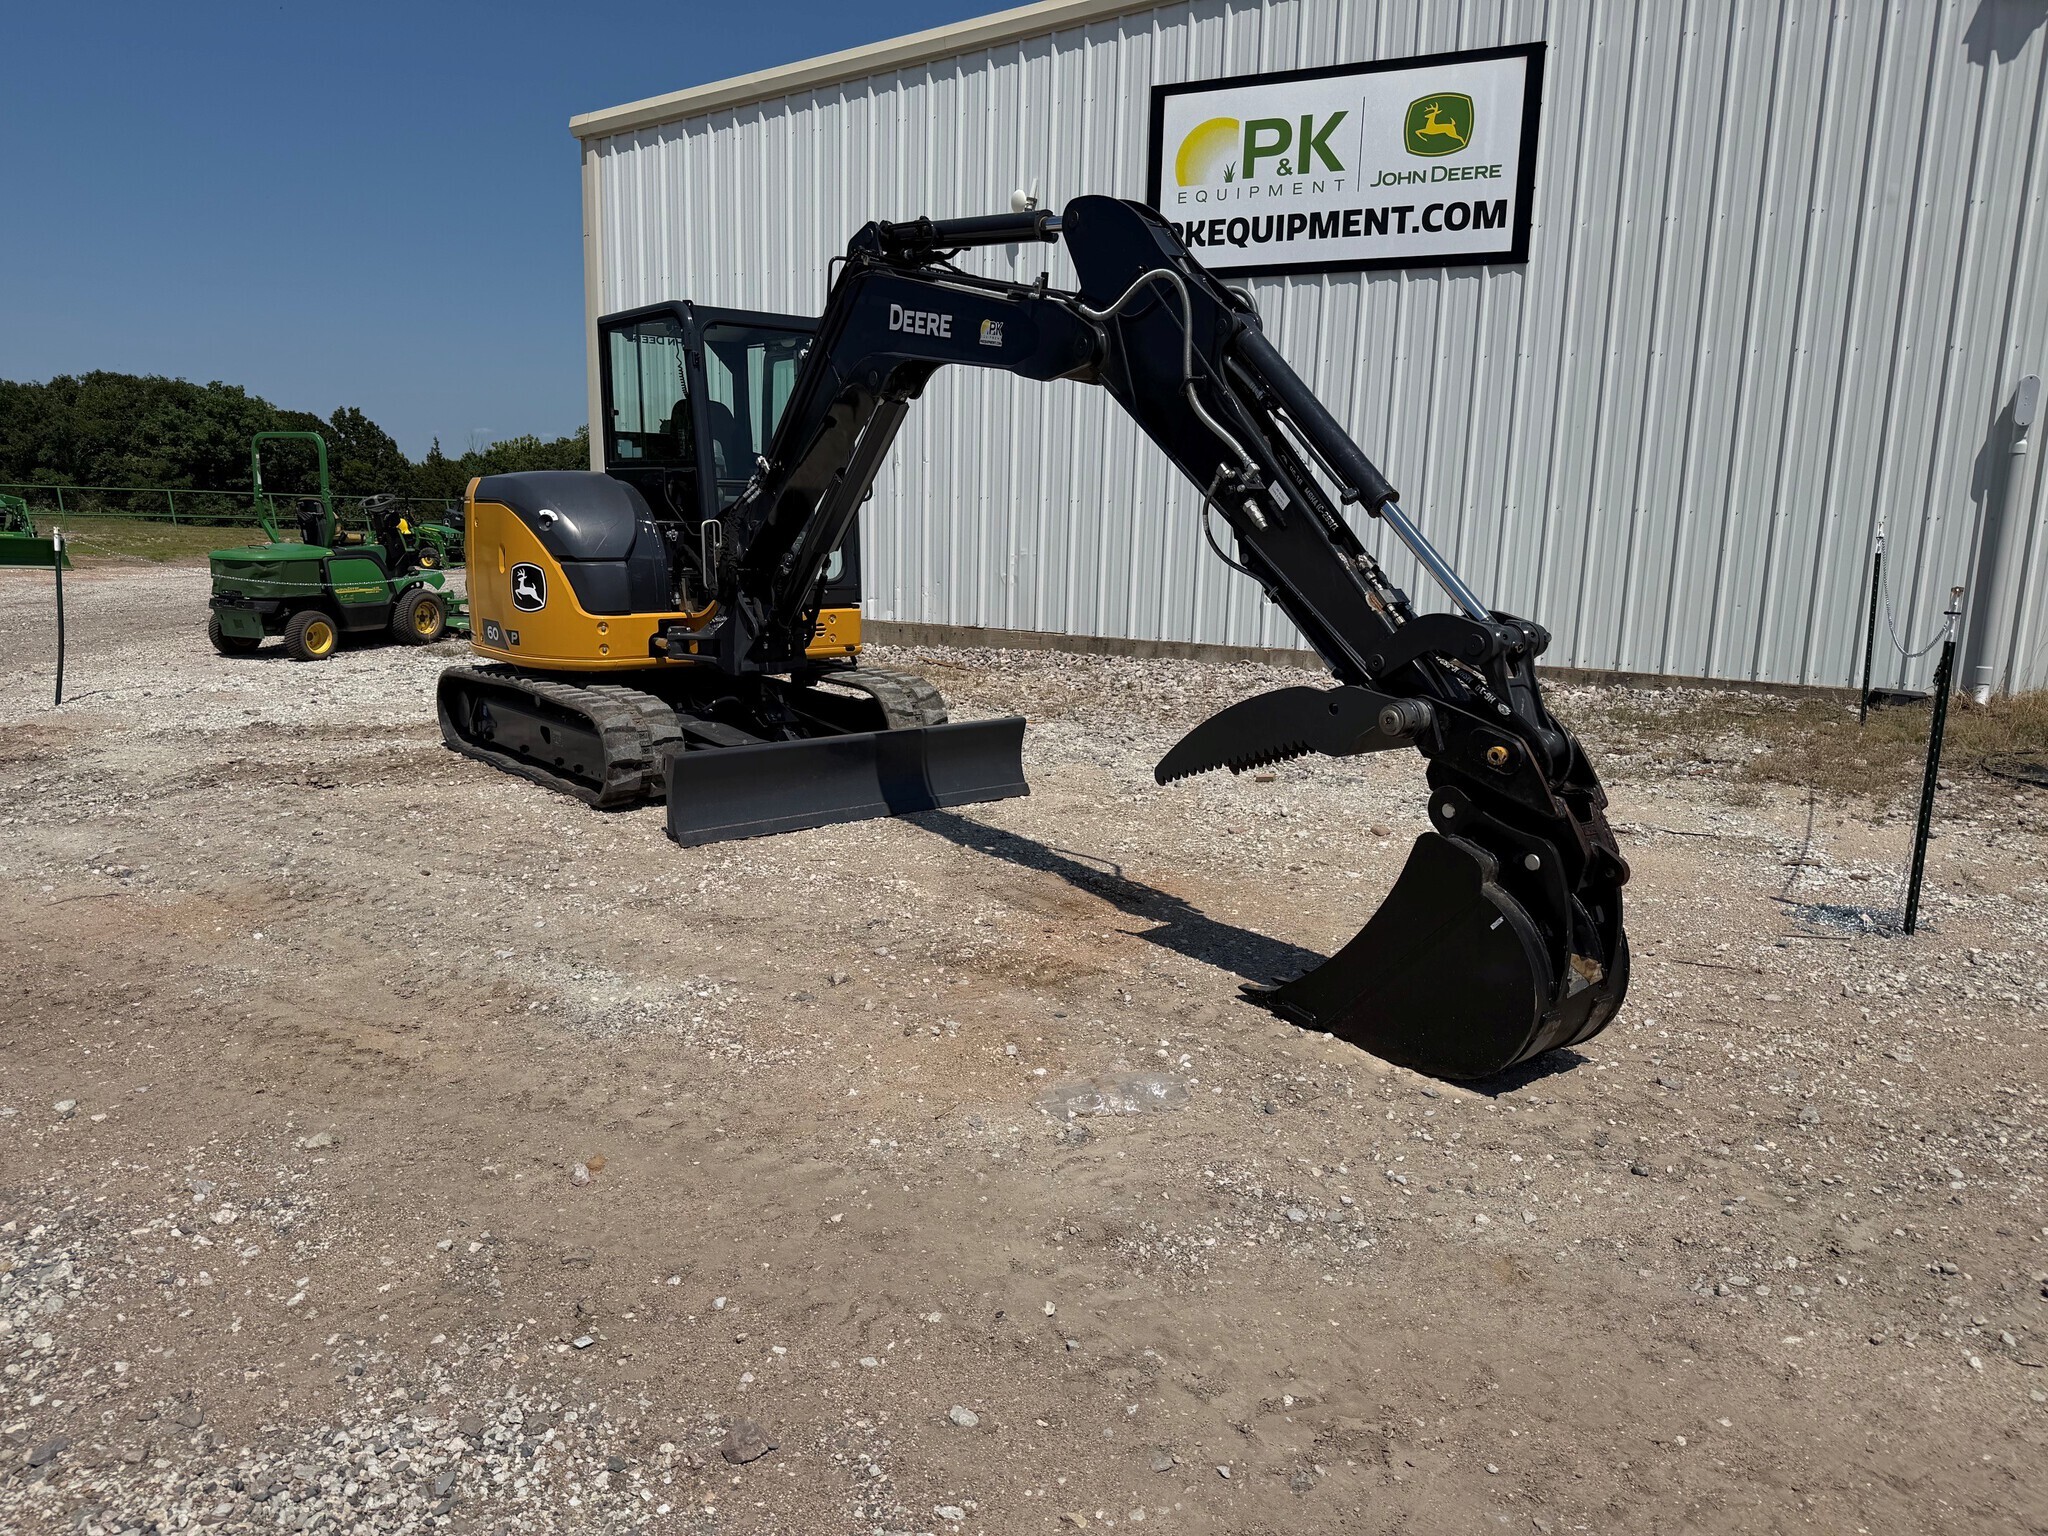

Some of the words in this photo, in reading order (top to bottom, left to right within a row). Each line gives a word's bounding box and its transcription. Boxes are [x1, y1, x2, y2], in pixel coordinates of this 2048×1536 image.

[1242, 110, 1349, 179] P&K
[1370, 170, 1426, 187] JOHN
[1431, 164, 1502, 183] DEERE
[1177, 178, 1346, 204] EQUIPMENT
[889, 303, 953, 338] DEERE
[487, 625, 499, 641] 60
[511, 632, 518, 643] P
